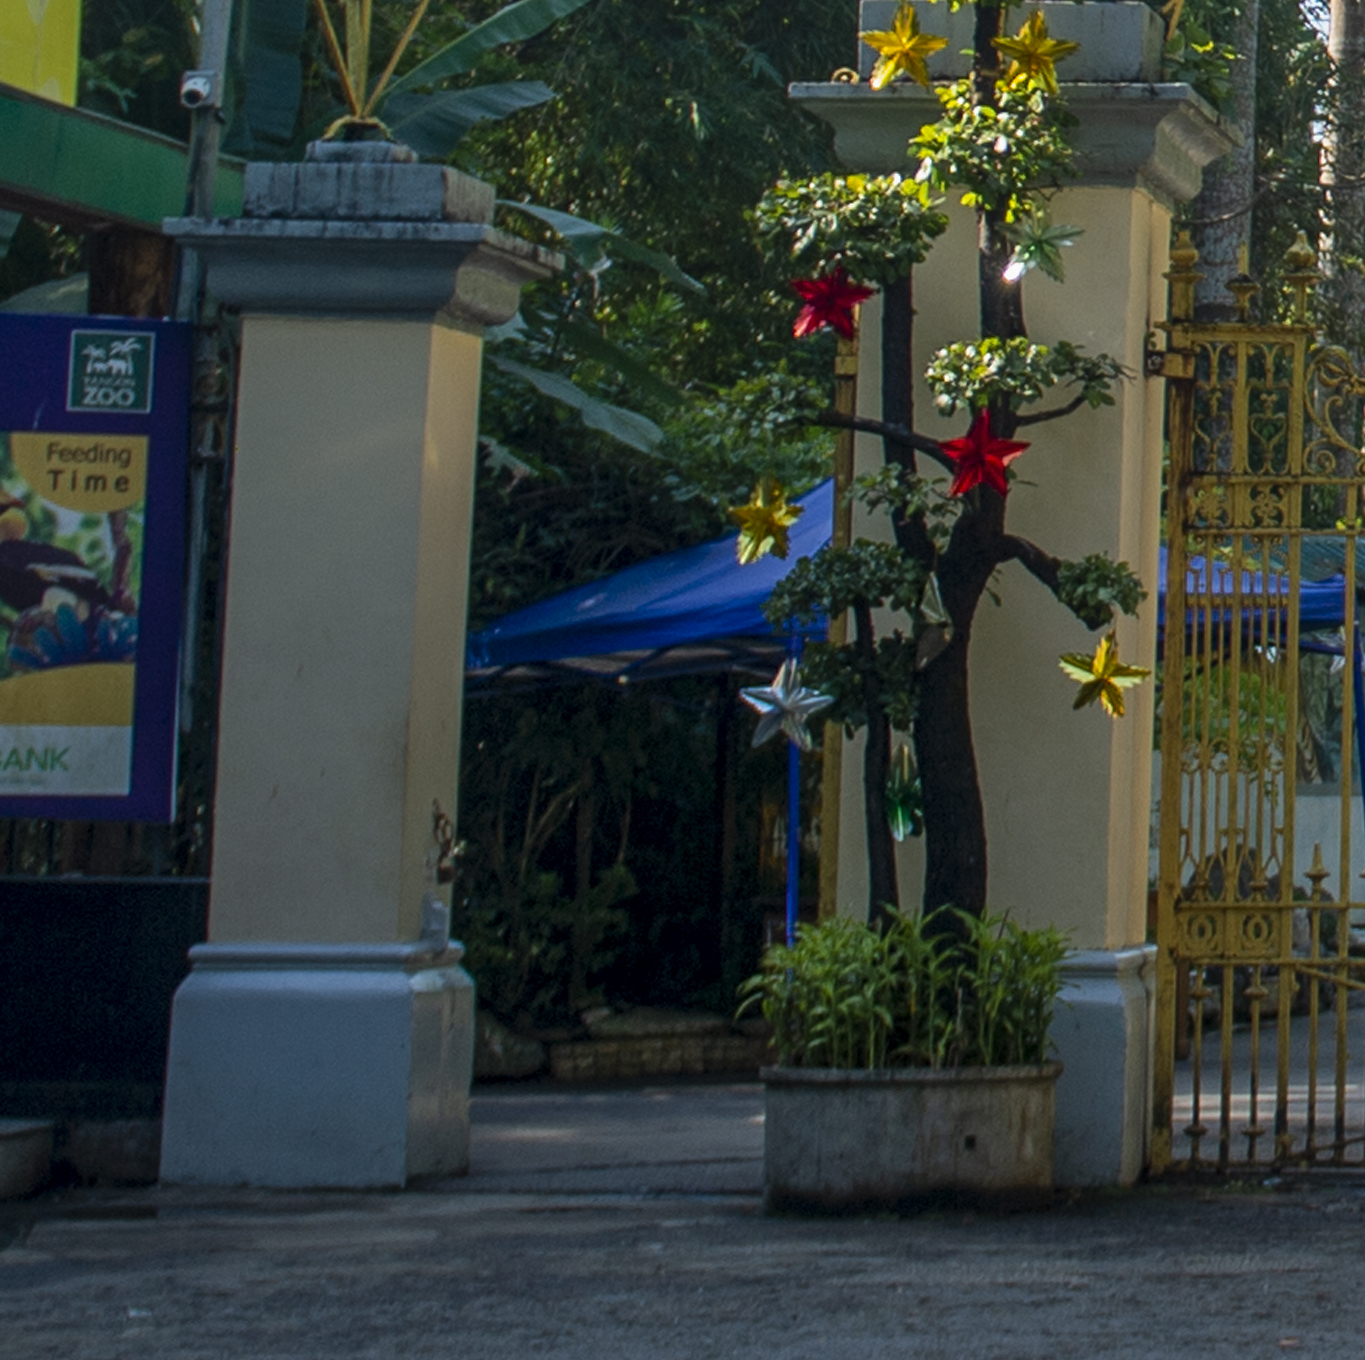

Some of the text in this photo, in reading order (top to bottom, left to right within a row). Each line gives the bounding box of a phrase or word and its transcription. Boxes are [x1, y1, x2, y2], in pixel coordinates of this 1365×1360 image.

[83, 387, 135, 406] ZOO
[47, 442, 131, 469] Feeding
[47, 470, 130, 493] Time
[0, 745, 71, 772] ANK
